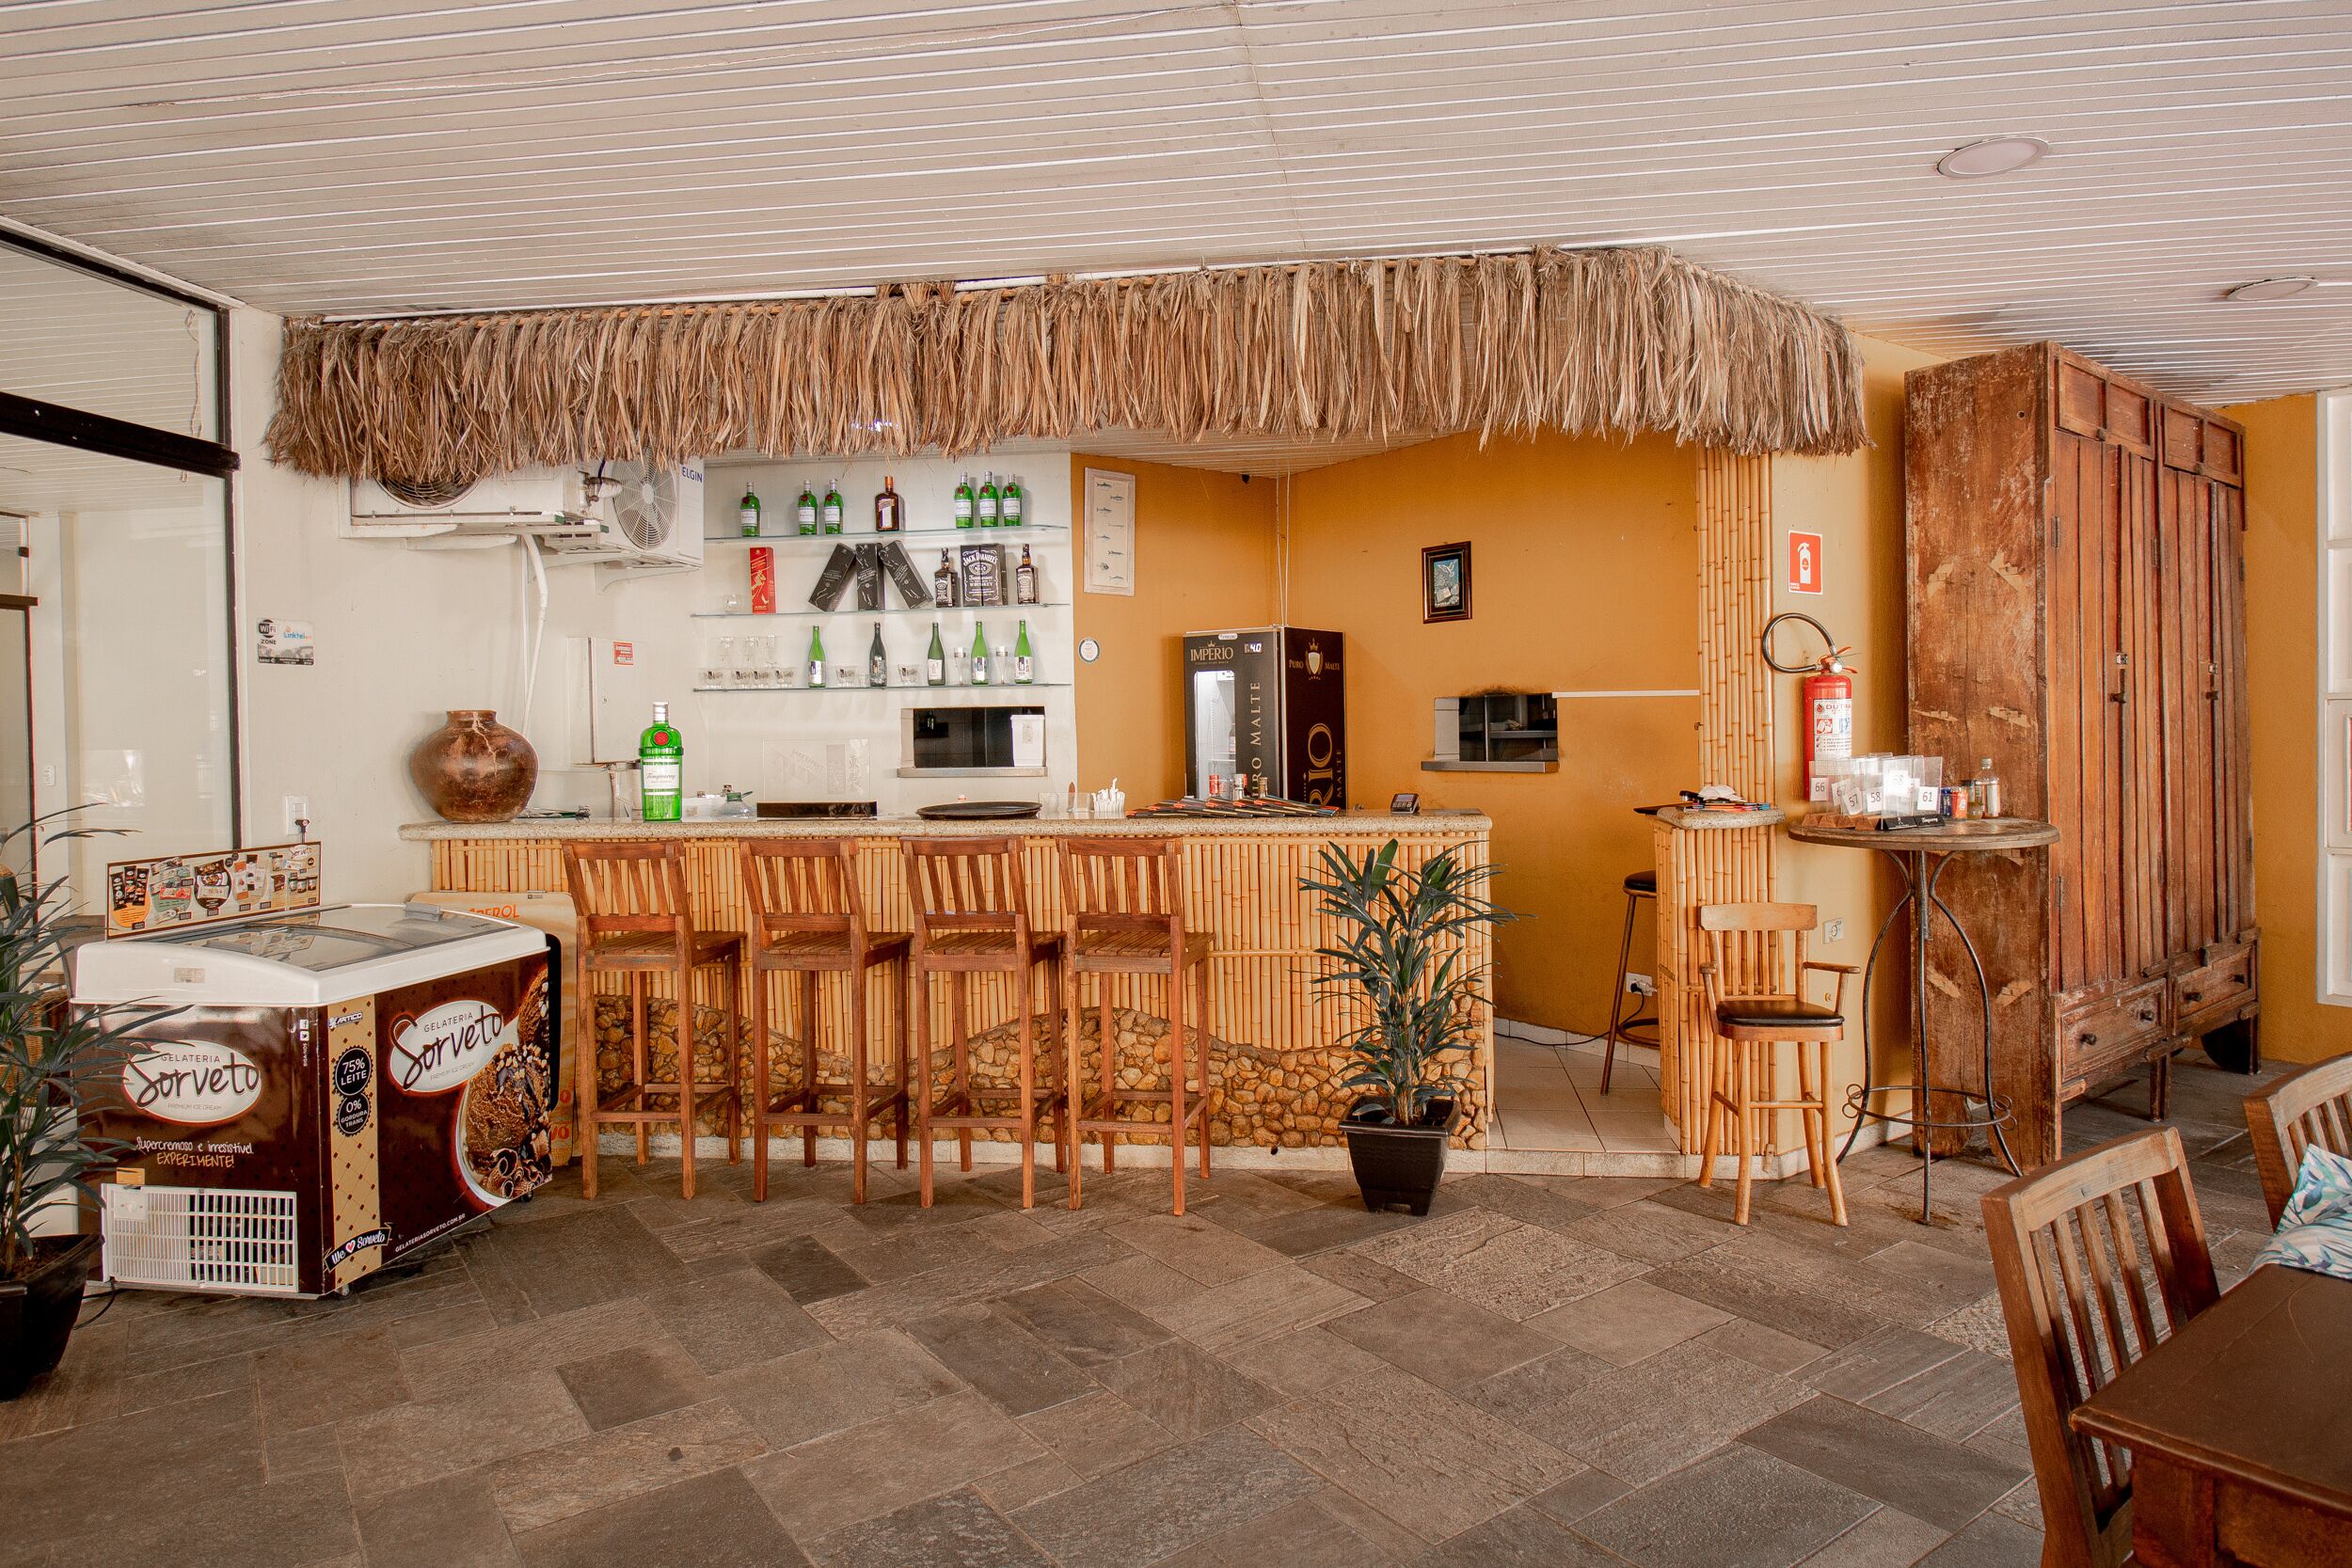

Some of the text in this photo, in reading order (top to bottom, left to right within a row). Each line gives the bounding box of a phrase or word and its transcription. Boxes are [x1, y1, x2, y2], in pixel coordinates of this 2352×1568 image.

[681, 466, 703, 483] ELGIN
[962, 551, 997, 566] JACK DANIEL'S
[1289, 659, 1304, 670] PURO
[1325, 662, 1341, 671] MALTE
[1249, 681, 1262, 747] MALTE
[1815, 782, 1825, 792] 66
[1848, 793, 1858, 807] 57
[1870, 791, 1881, 803] 58
[1922, 791, 1933, 802] 61
[423, 1011, 474, 1033] GELATERIA
[390, 1004, 502, 1090] Sorveto
[160, 1053, 222, 1064] GELATERIA
[342, 1056, 366, 1075] 75%
[126, 1043, 260, 1109] Sorveto
[340, 1069, 368, 1087] LEITE
[345, 1098, 363, 1114] 0%
[340, 1109, 368, 1124] GORDURA
[344, 1117, 364, 1129] TRANS
[135, 1135, 194, 1152] Supercremoso
[197, 1143, 204, 1153] e
[156, 1151, 235, 1168] EXPERIMENTE!
[394, 1212, 466, 1253] GELATERIASORVETO.COM.BR
[331, 1229, 386, 1265] We Sorveto
